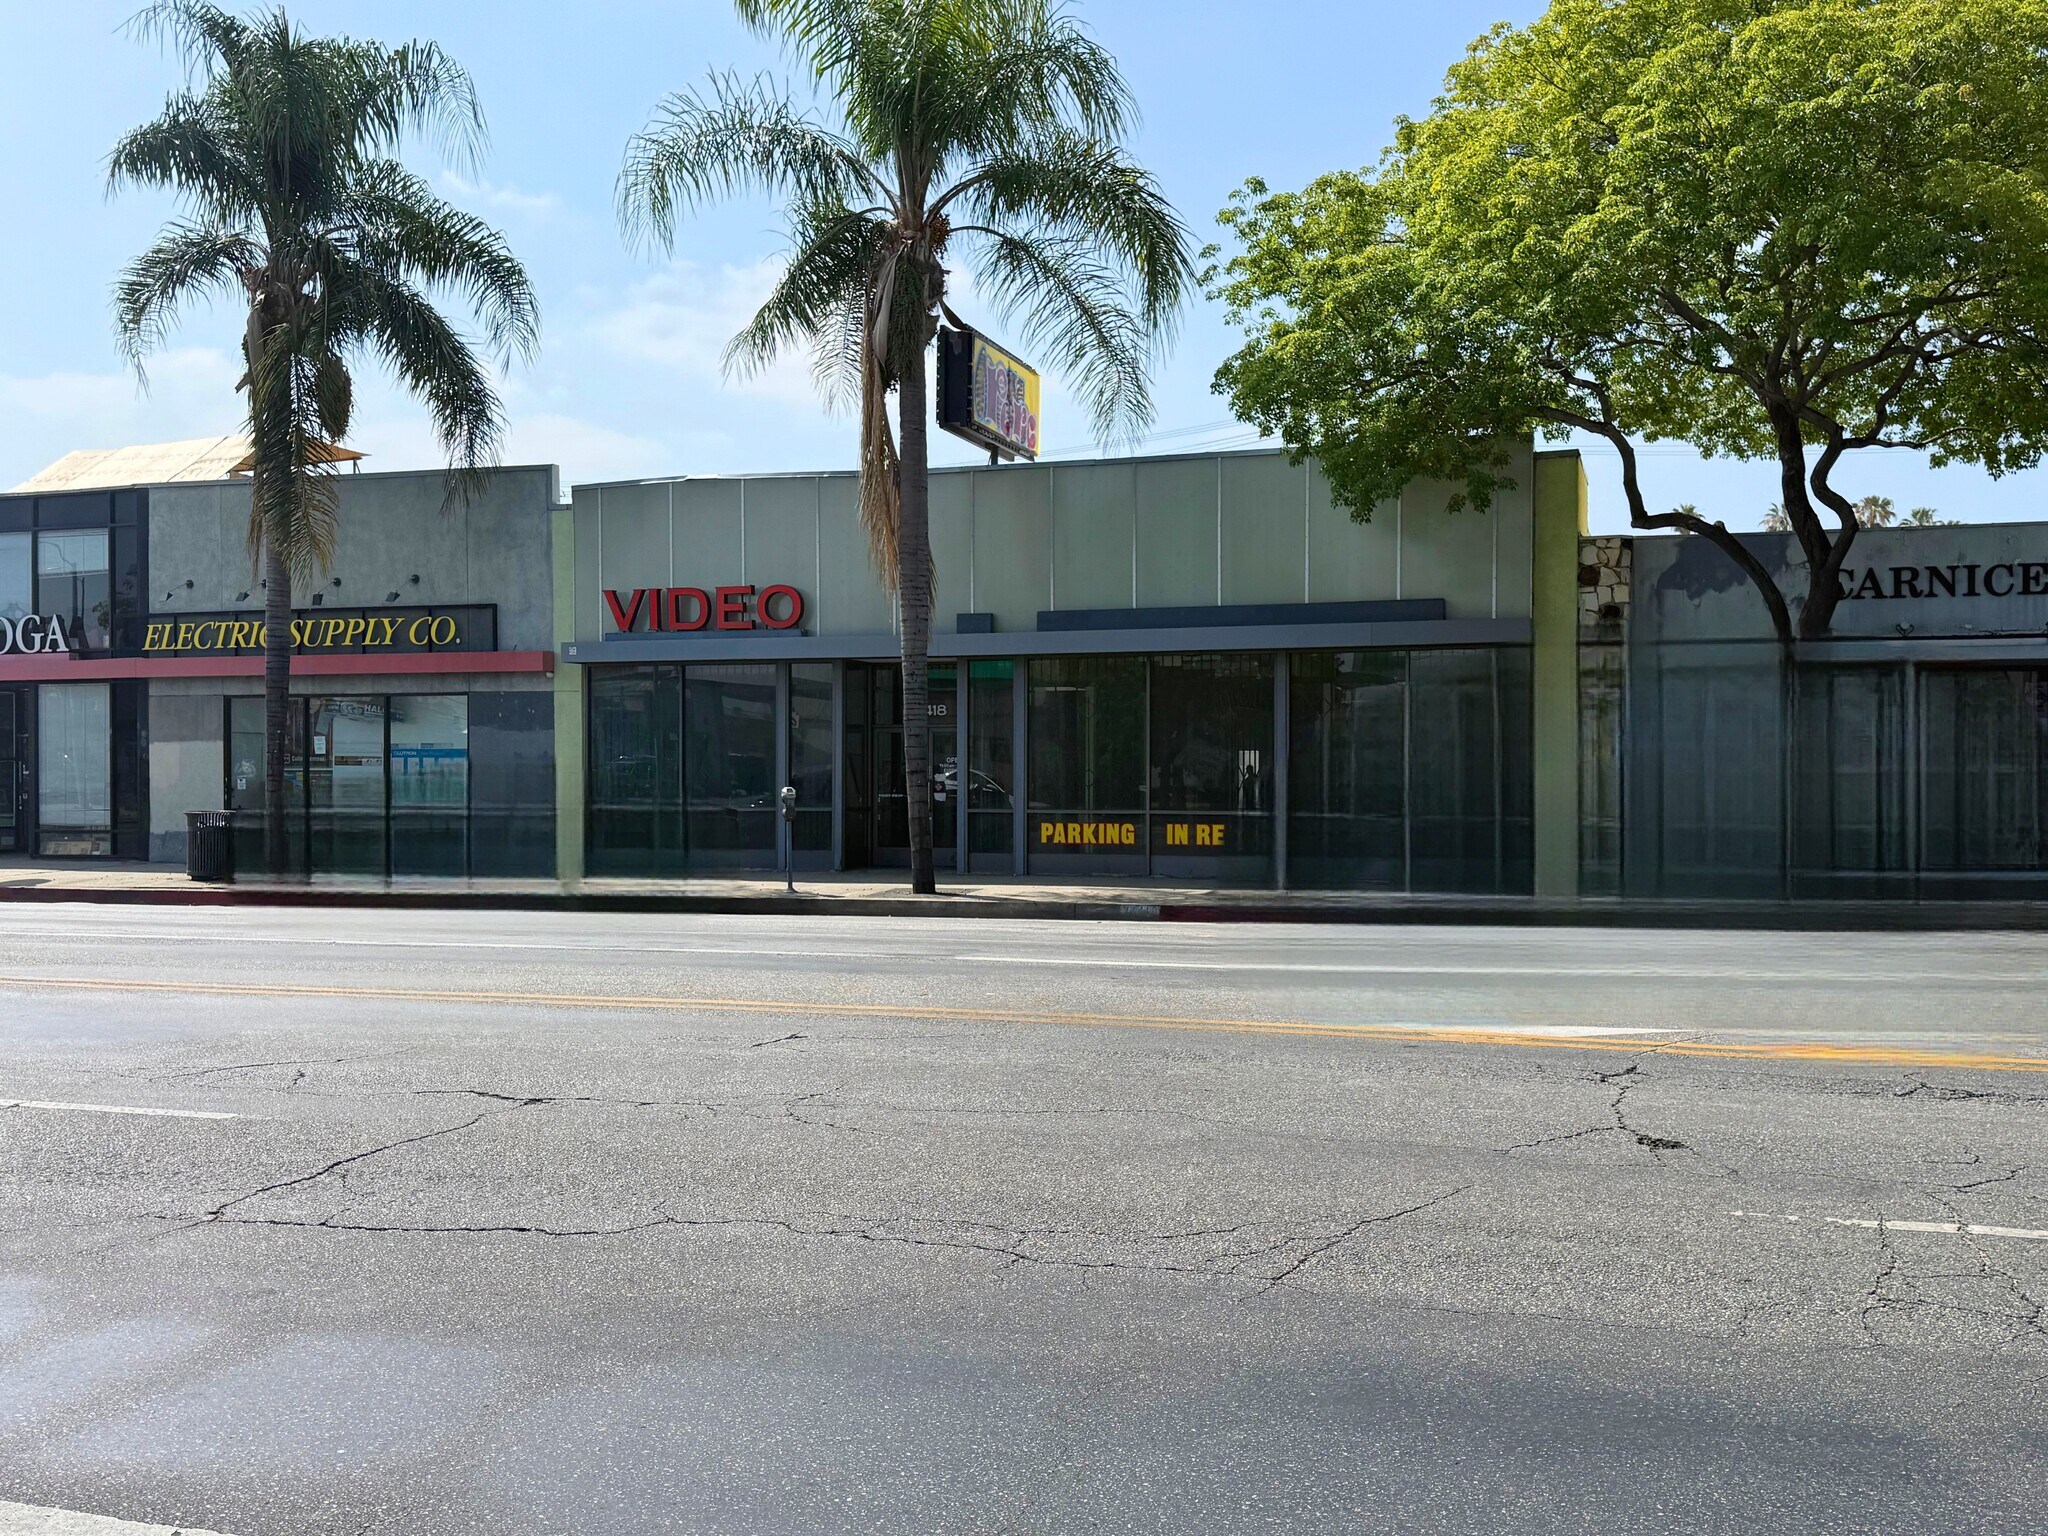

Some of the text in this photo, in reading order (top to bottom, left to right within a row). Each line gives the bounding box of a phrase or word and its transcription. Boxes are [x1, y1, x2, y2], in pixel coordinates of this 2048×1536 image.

[603, 585, 804, 632] VIDEO
[290, 617, 405, 648] SUPPLY
[409, 616, 461, 645] CO.
[1040, 822, 1225, 846] PARKING IN RE
